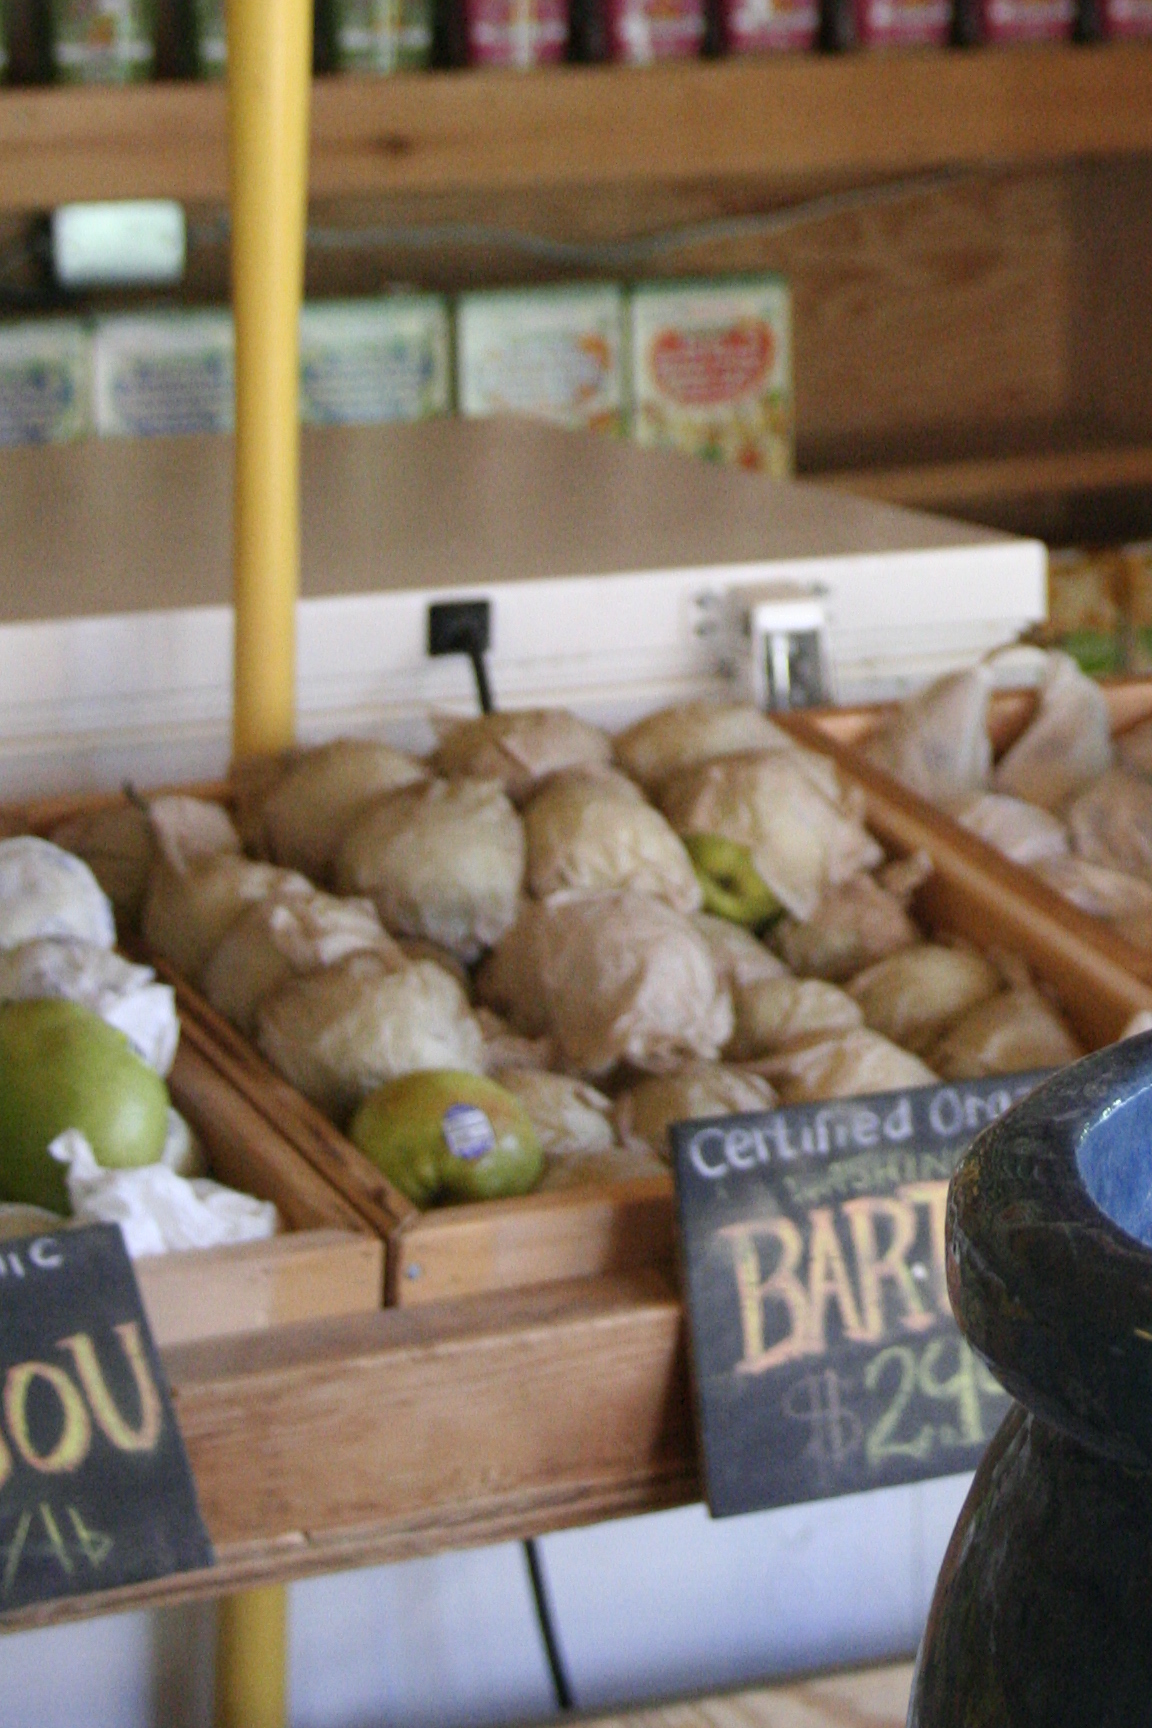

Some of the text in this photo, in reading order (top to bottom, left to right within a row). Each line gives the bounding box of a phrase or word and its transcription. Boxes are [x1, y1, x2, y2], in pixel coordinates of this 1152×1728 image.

[689, 1086, 1032, 1178] Certified Org
[0, 1322, 162, 1484] OU
